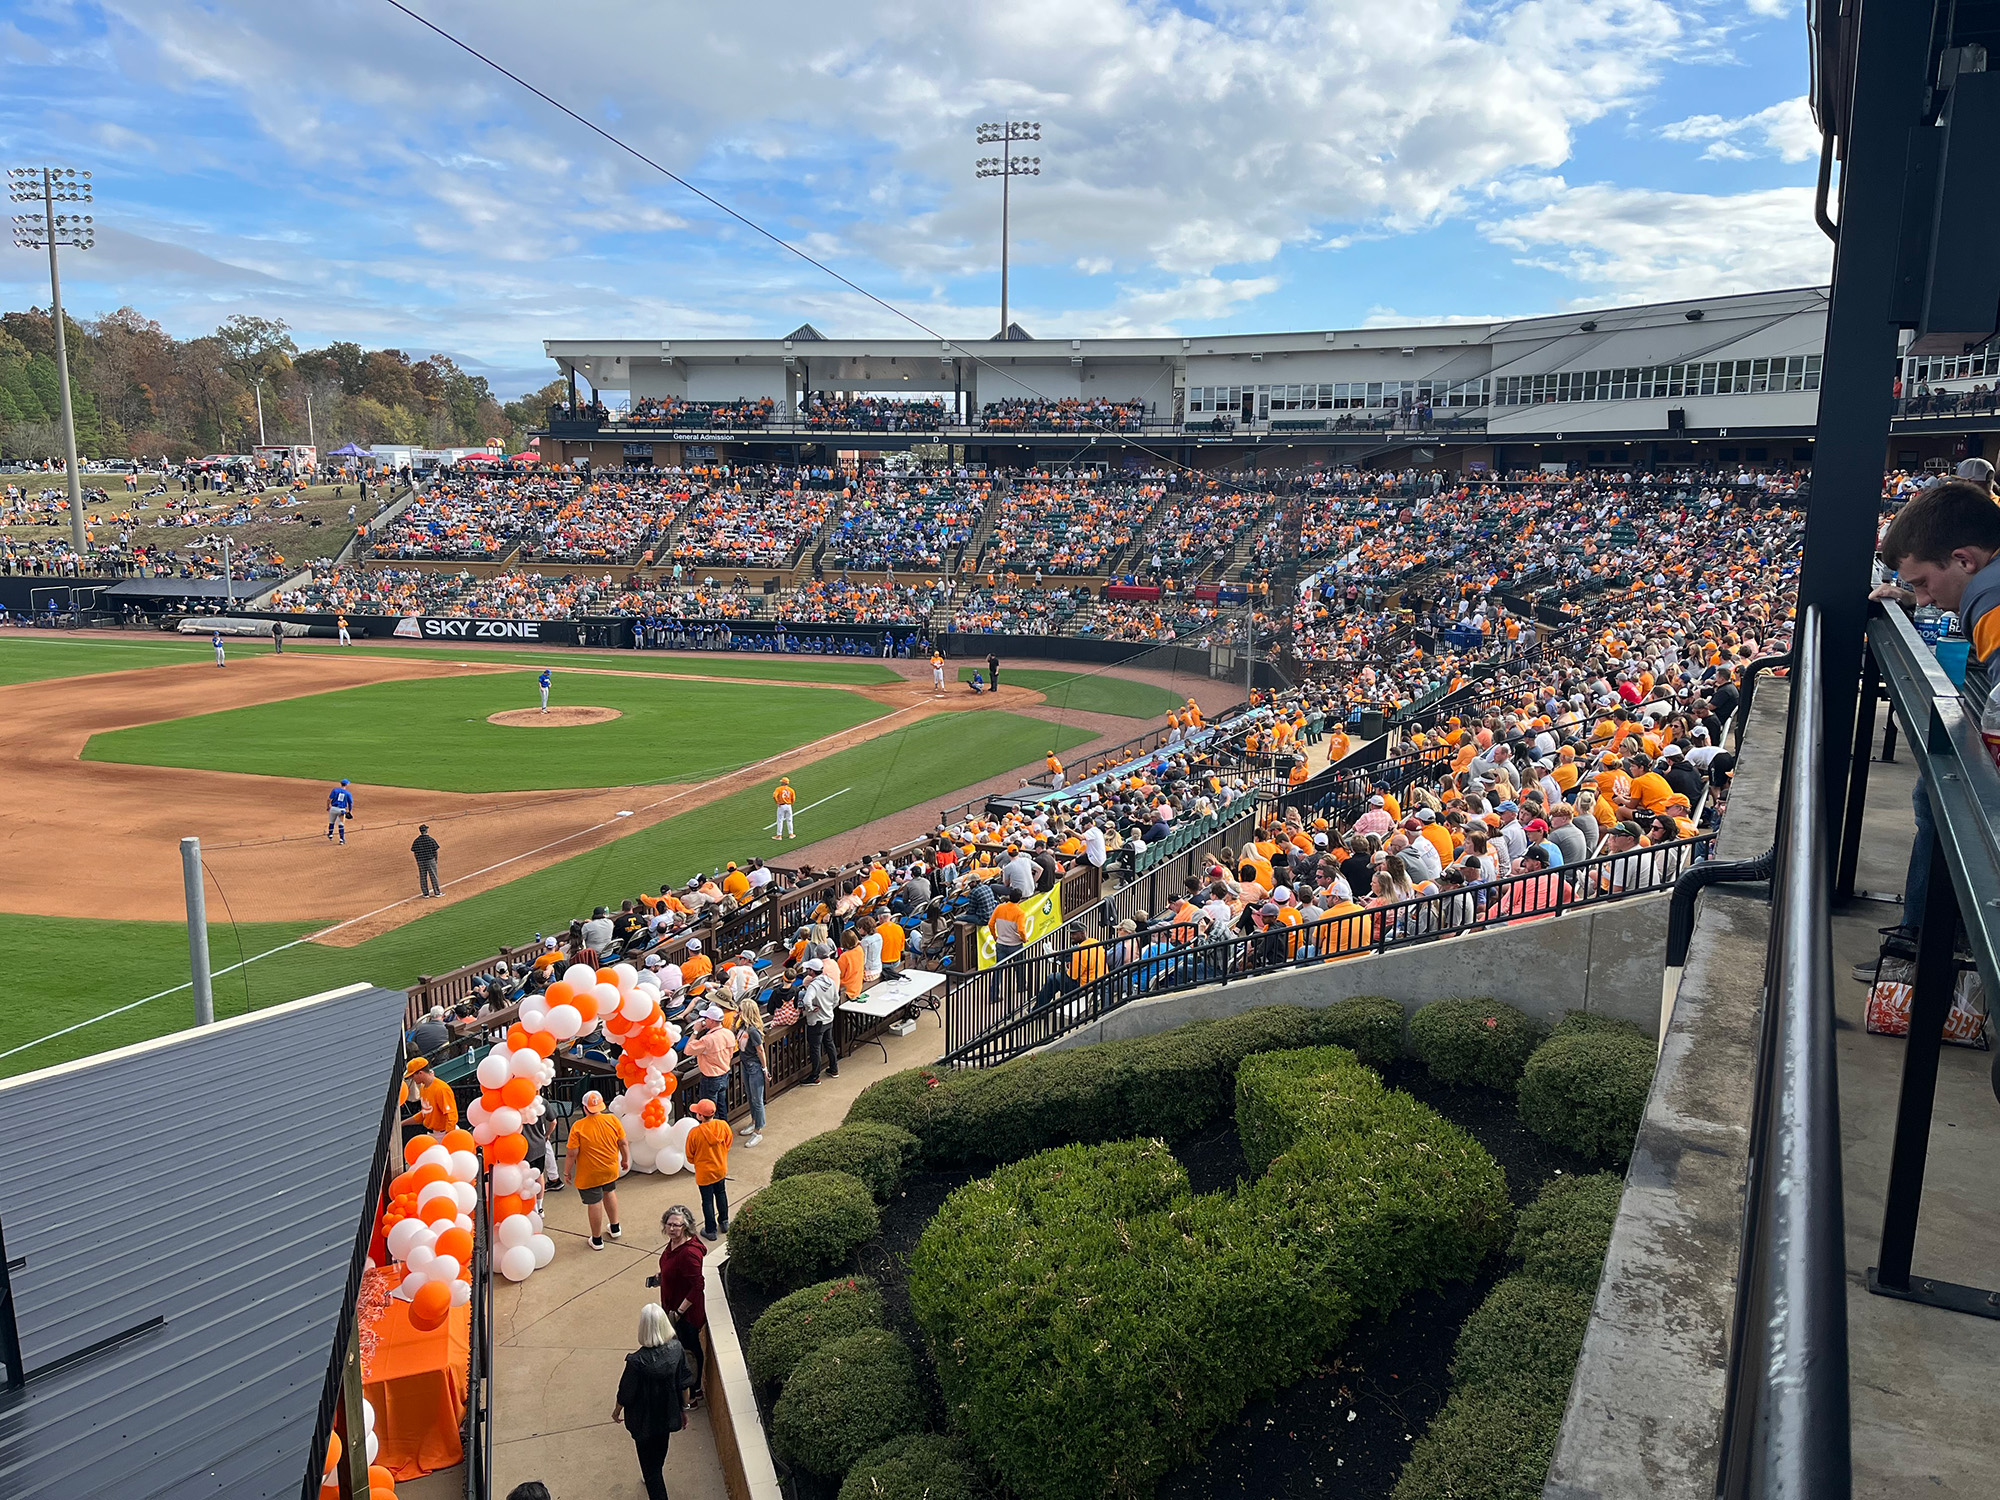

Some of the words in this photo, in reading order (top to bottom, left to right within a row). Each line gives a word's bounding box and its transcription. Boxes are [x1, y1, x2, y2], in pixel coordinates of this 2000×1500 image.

[700, 433, 735, 441] Admission
[1720, 428, 1727, 437] H
[425, 619, 470, 635] SKY
[475, 621, 539, 638] ZONE
[628, 917, 636, 926] T
